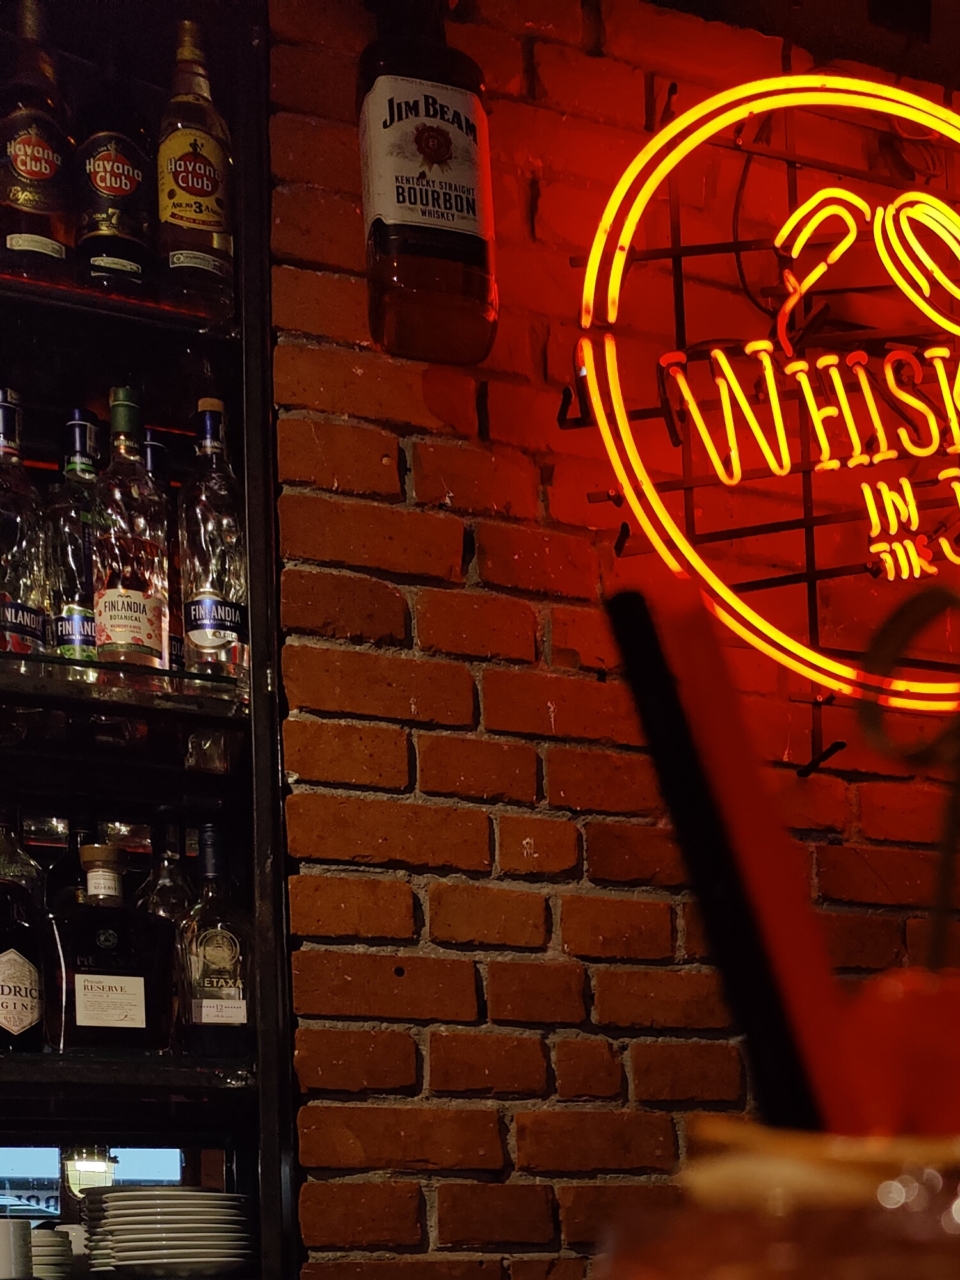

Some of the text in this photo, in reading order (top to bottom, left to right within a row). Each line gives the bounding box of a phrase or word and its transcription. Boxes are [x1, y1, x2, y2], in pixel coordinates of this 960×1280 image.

[383, 94, 478, 145] JIM BEAM
[7, 140, 61, 165] Havana
[17, 155, 50, 174] Club
[86, 157, 142, 182] Havana
[167, 157, 221, 180] Havana
[96, 172, 130, 190] Club
[178, 172, 212, 191] Club
[439, 182, 475, 197] STRAIGHT
[193, 201, 203, 214] 3
[396, 186, 476, 216] BOURBON
[107, 207, 120, 225] 7
[420, 208, 455, 221] WHISKEY
[860, 476, 920, 538] IN
[103, 600, 148, 616] FINLANDIA
[109, 614, 142, 623] BOTANICAL
[83, 984, 127, 993] RESERVE
[1, 1001, 29, 1011] GIN
